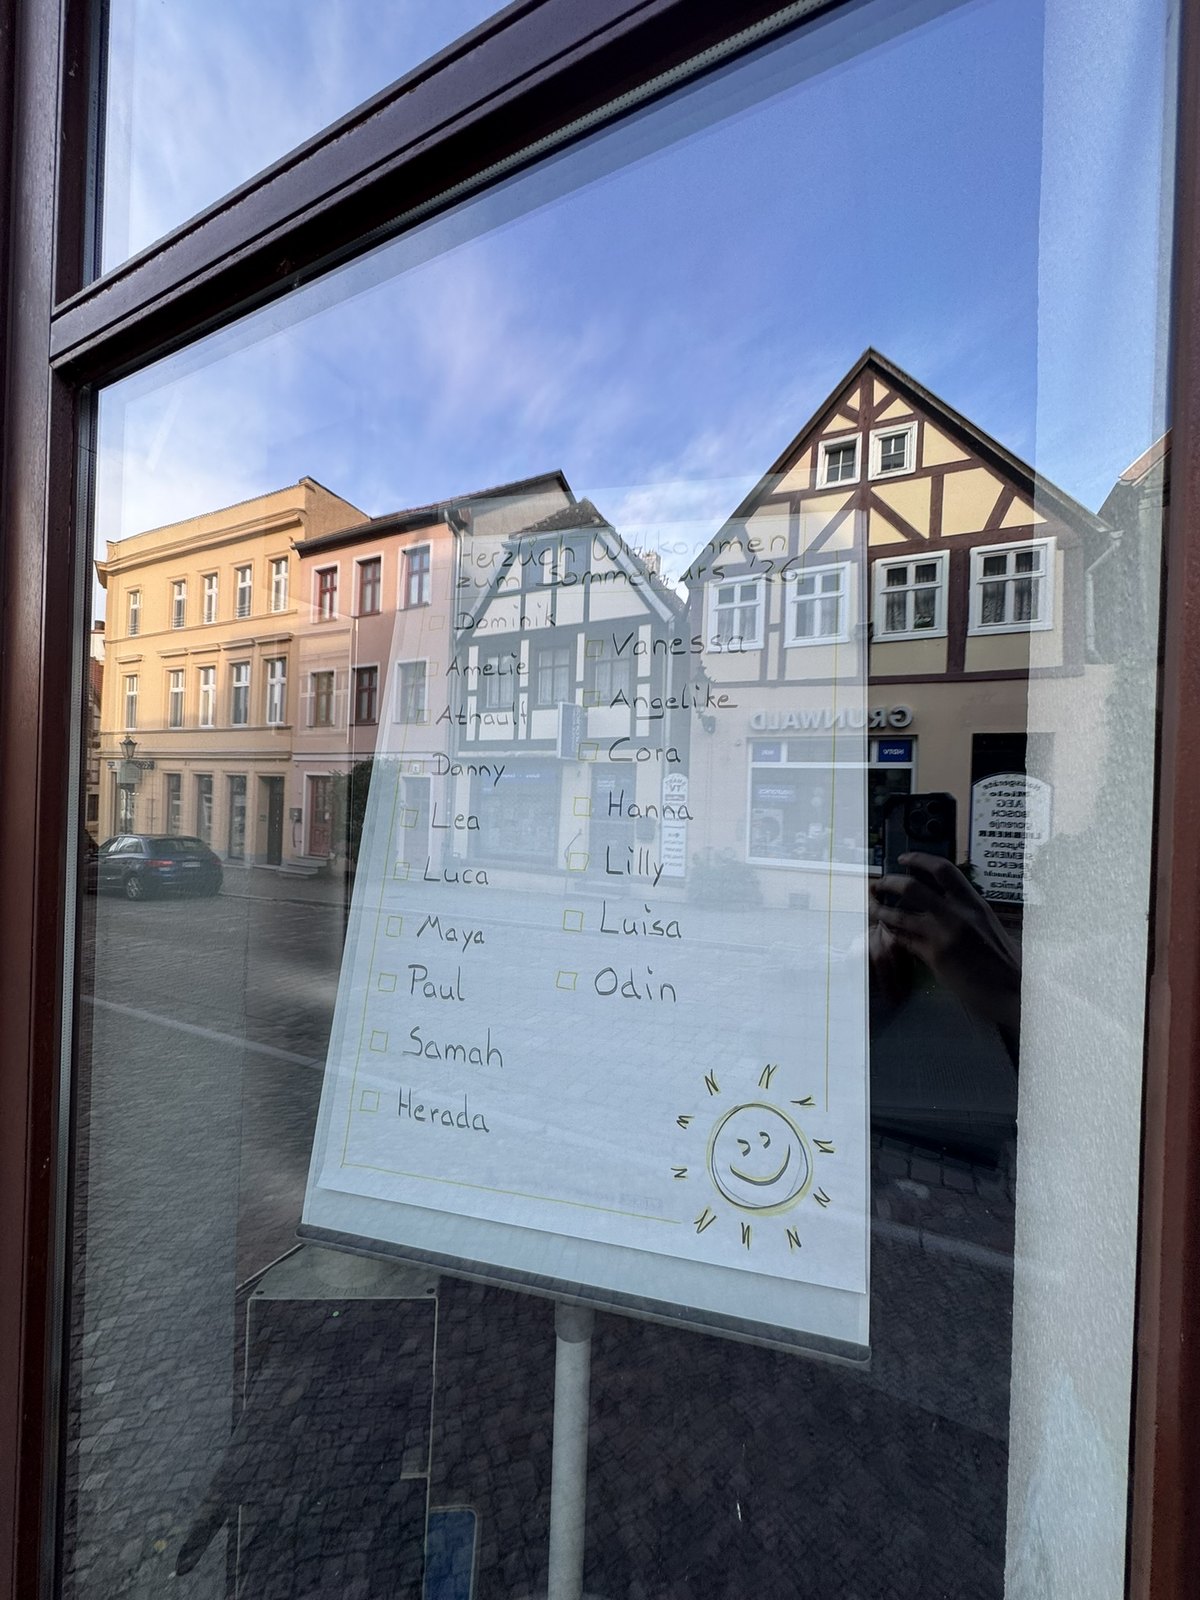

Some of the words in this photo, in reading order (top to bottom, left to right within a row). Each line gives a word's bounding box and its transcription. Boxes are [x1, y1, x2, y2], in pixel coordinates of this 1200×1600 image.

[460, 535, 576, 568] Herzlich
[592, 529, 787, 561] Willkommen
[456, 575, 520, 588] zum
[749, 555, 799, 583] '26
[454, 602, 557, 630] Dominik
[611, 631, 751, 656] Vanessa
[445, 651, 529, 677] Amelie
[609, 683, 740, 719] Angelike
[608, 736, 682, 763] Cora
[431, 752, 506, 787] Danny
[431, 802, 481, 831] Lea
[607, 789, 694, 821] Hanna
[422, 855, 490, 886] Luca
[605, 845, 665, 888] Lilly
[416, 914, 486, 953] Maya
[599, 900, 683, 939] Luisa
[407, 963, 467, 1002] Paul
[594, 966, 677, 1003] Odin
[402, 1025, 503, 1068] Samah
[398, 1086, 490, 1133] Herada
